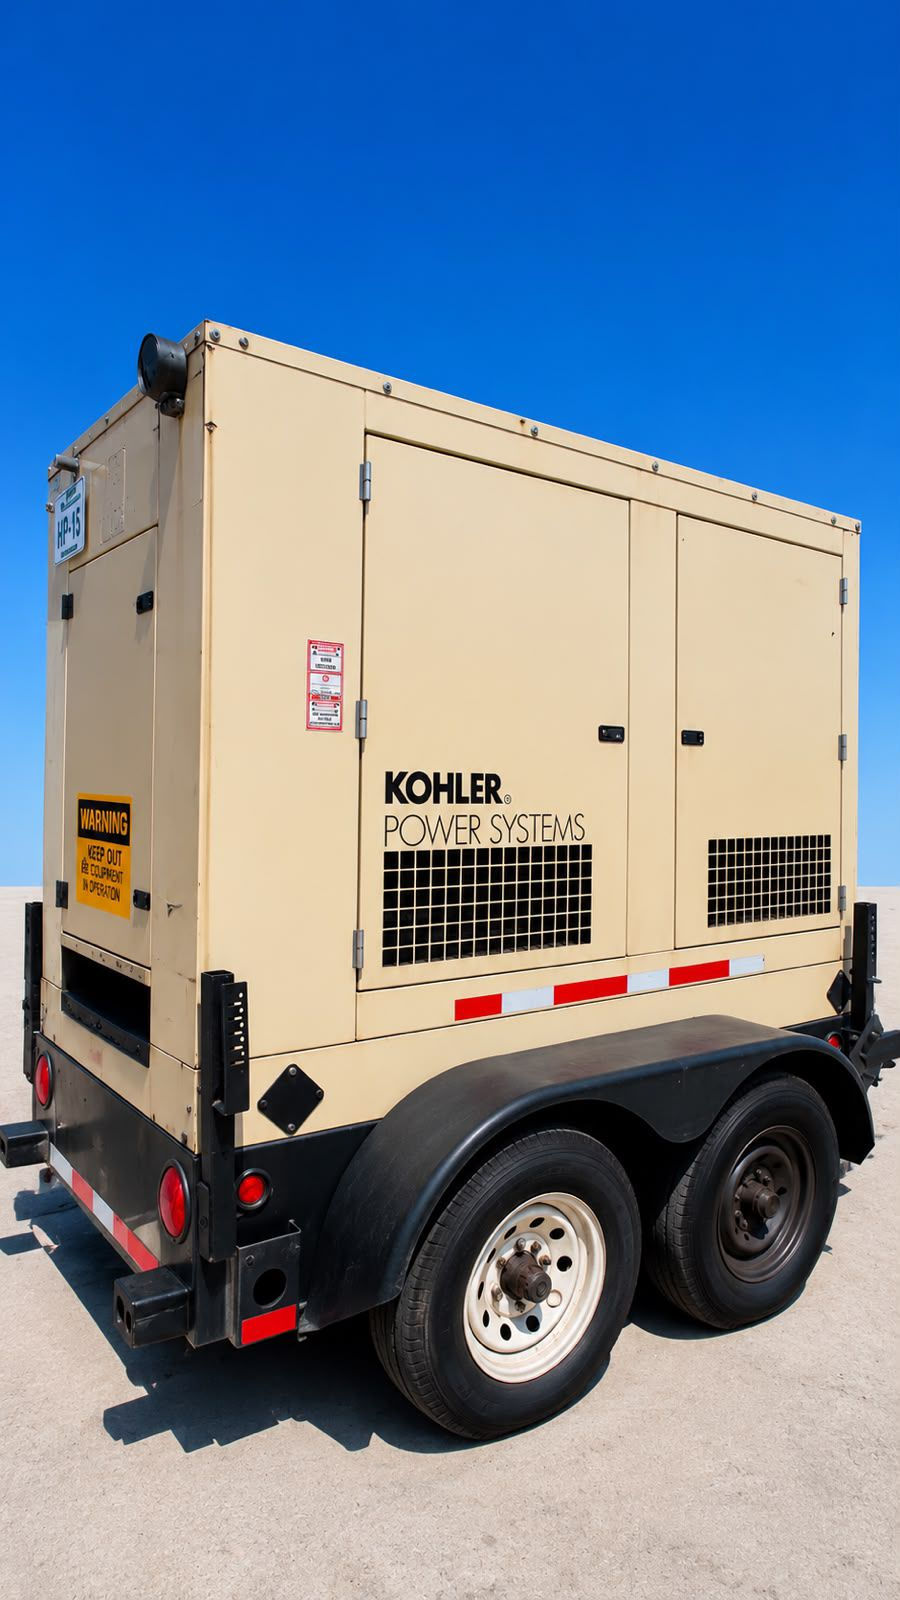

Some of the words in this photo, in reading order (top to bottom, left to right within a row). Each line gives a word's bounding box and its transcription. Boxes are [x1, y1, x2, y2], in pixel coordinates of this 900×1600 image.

[57, 506, 81, 549] HP-15
[80, 808, 128, 836] WARNING
[385, 814, 481, 847] POWER
[489, 813, 586, 844] SYSTEMS
[87, 844, 105, 862] KEEP
[106, 848, 122, 867] OUT
